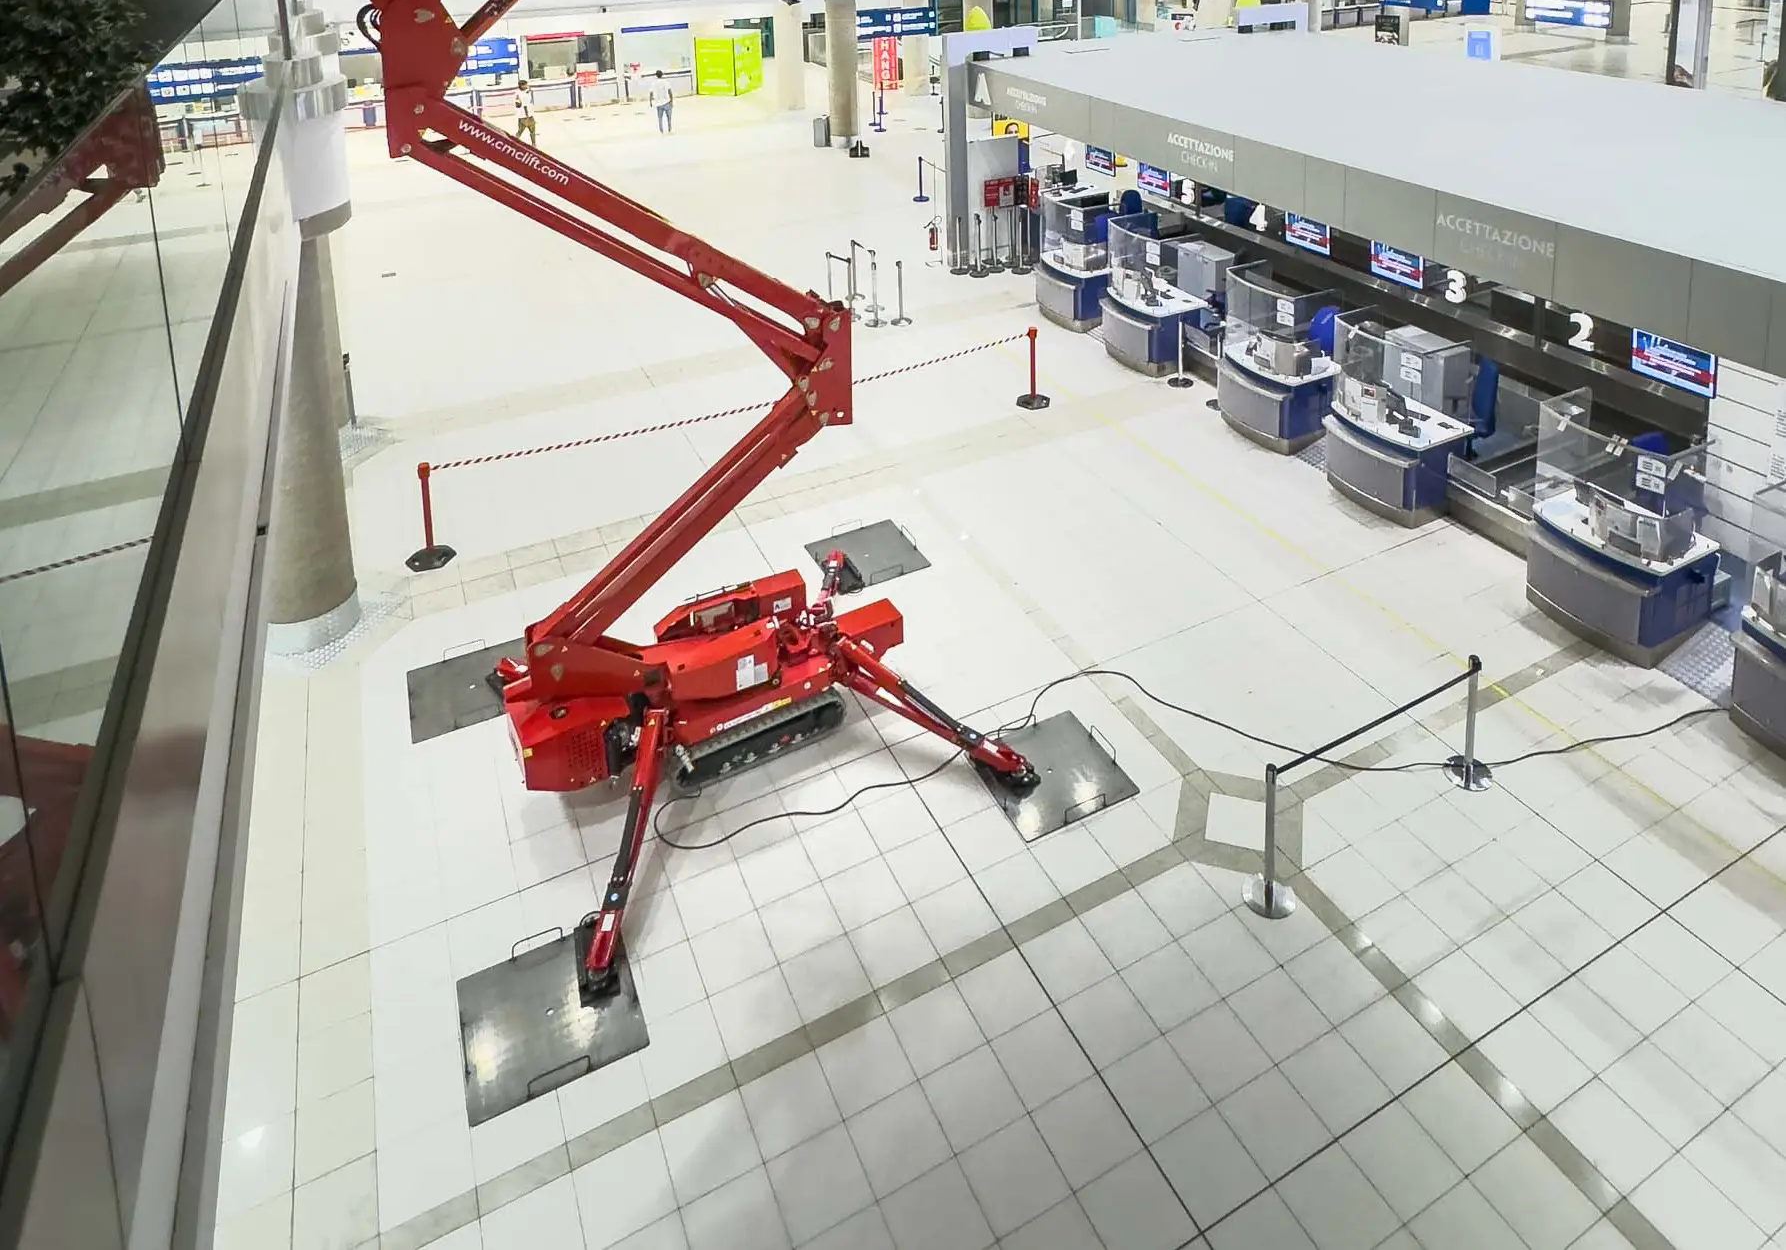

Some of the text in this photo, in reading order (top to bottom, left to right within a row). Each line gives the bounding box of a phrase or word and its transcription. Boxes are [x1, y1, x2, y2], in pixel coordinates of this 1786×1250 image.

[459, 120, 569, 185] www.cmclift.com
[1167, 132, 1234, 162] ACCETTAZIONE
[1249, 203, 1268, 232] 4
[1436, 210, 1556, 258] ACCETTAZIONE
[1445, 269, 1467, 303] 3
[1568, 312, 1595, 352] 2
